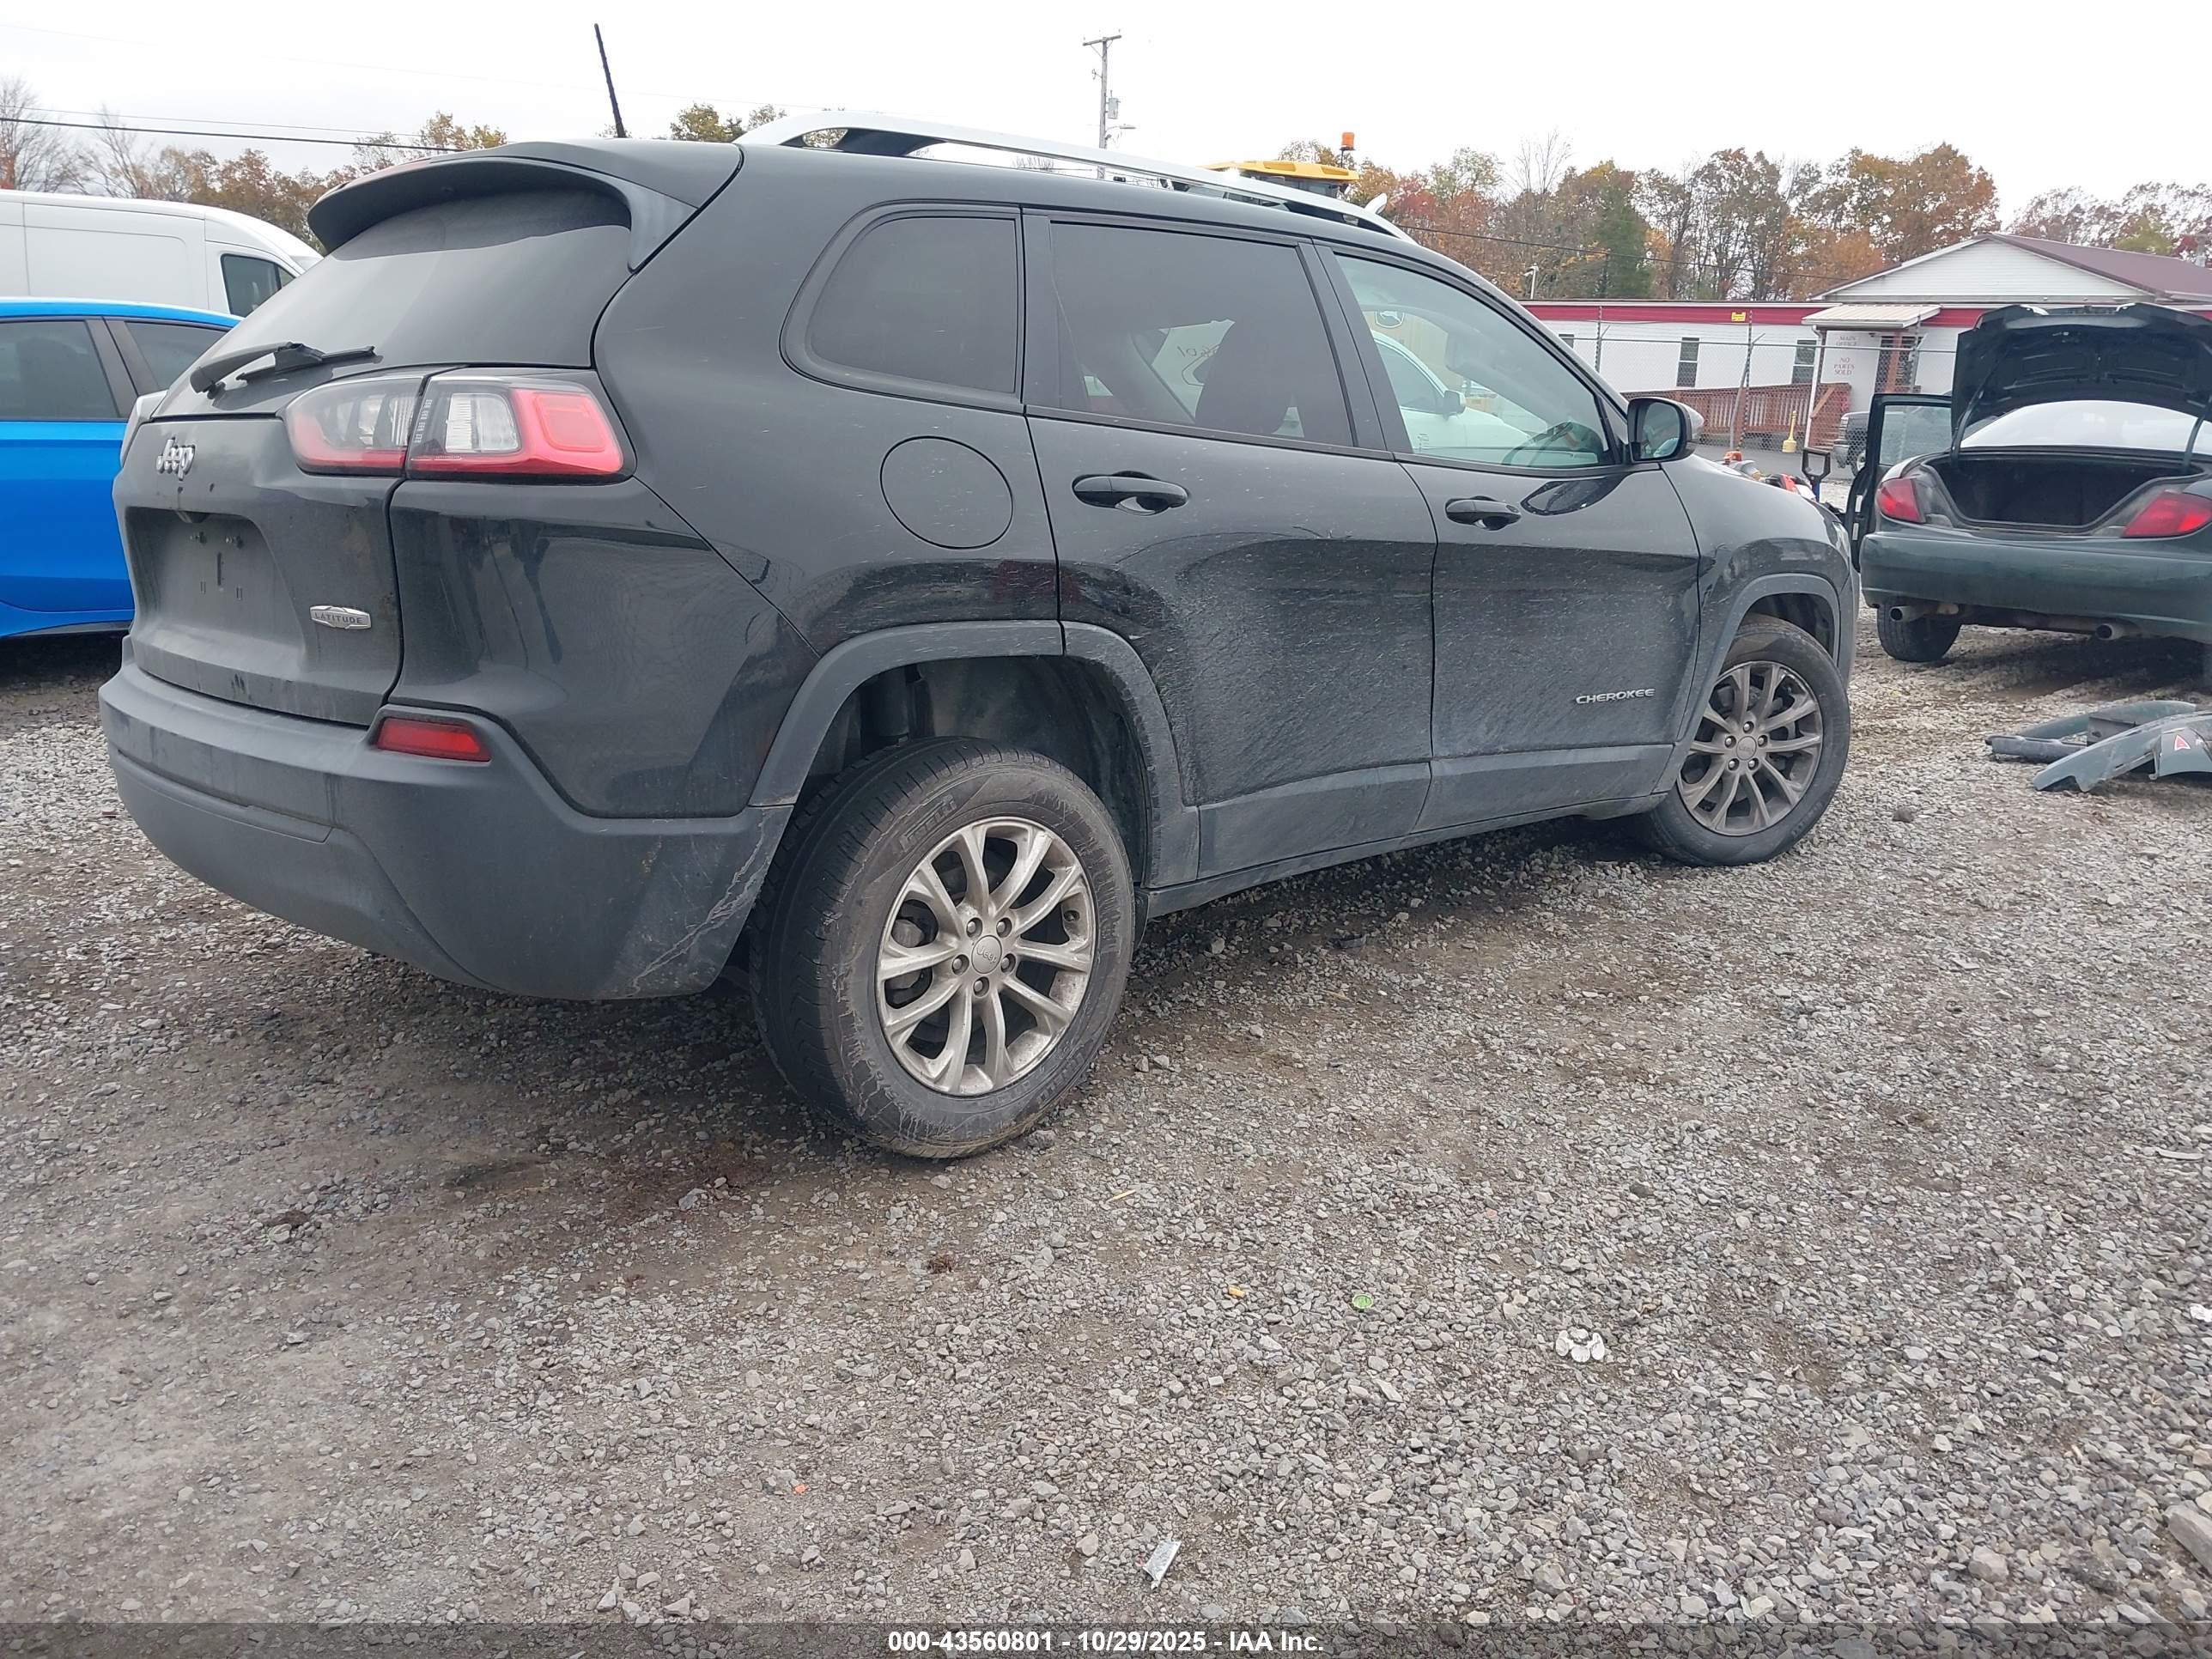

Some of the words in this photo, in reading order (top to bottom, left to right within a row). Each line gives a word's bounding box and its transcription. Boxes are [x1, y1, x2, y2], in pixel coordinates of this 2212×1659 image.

[155, 436, 196, 482] Jeep
[314, 612, 362, 624] LATITUDE
[1575, 688, 1656, 704] CHEROKEE
[976, 946, 997, 964] Jeep
